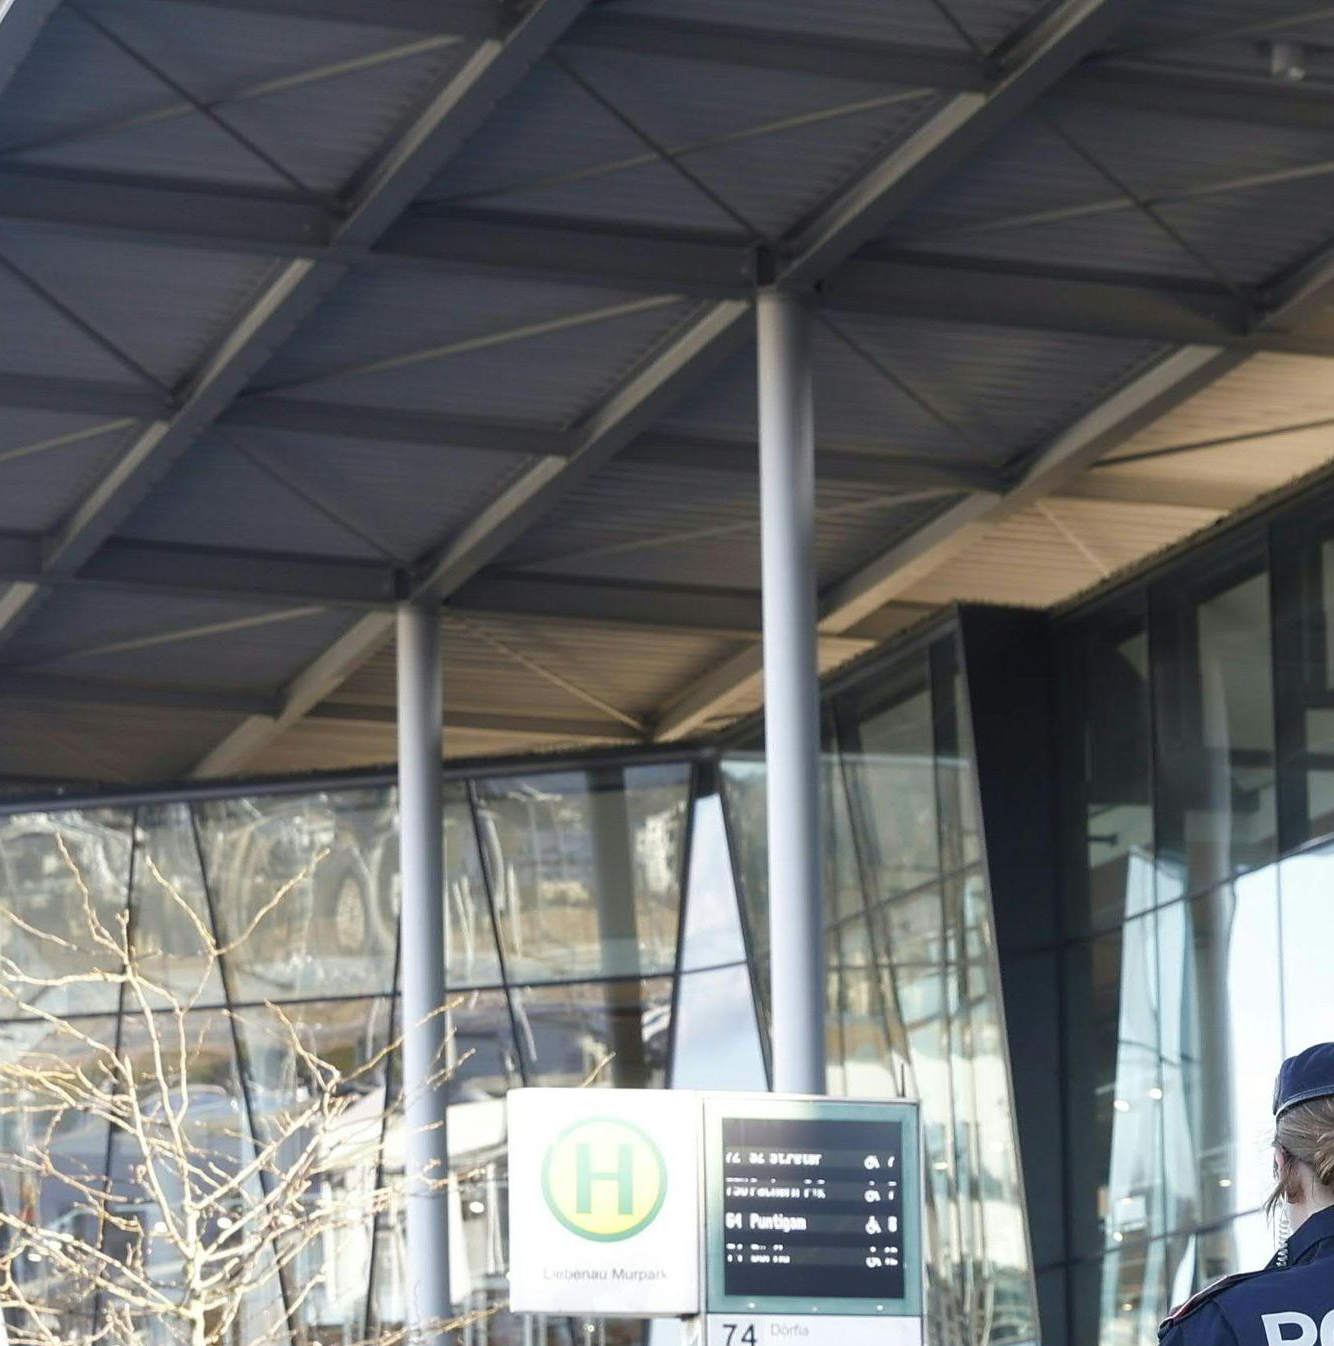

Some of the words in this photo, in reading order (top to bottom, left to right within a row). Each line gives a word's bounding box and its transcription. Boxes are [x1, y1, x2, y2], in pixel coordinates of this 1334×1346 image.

[576, 1143, 634, 1215] H
[750, 1213, 807, 1233] Puntigam
[611, 1267, 668, 1282] Murpark
